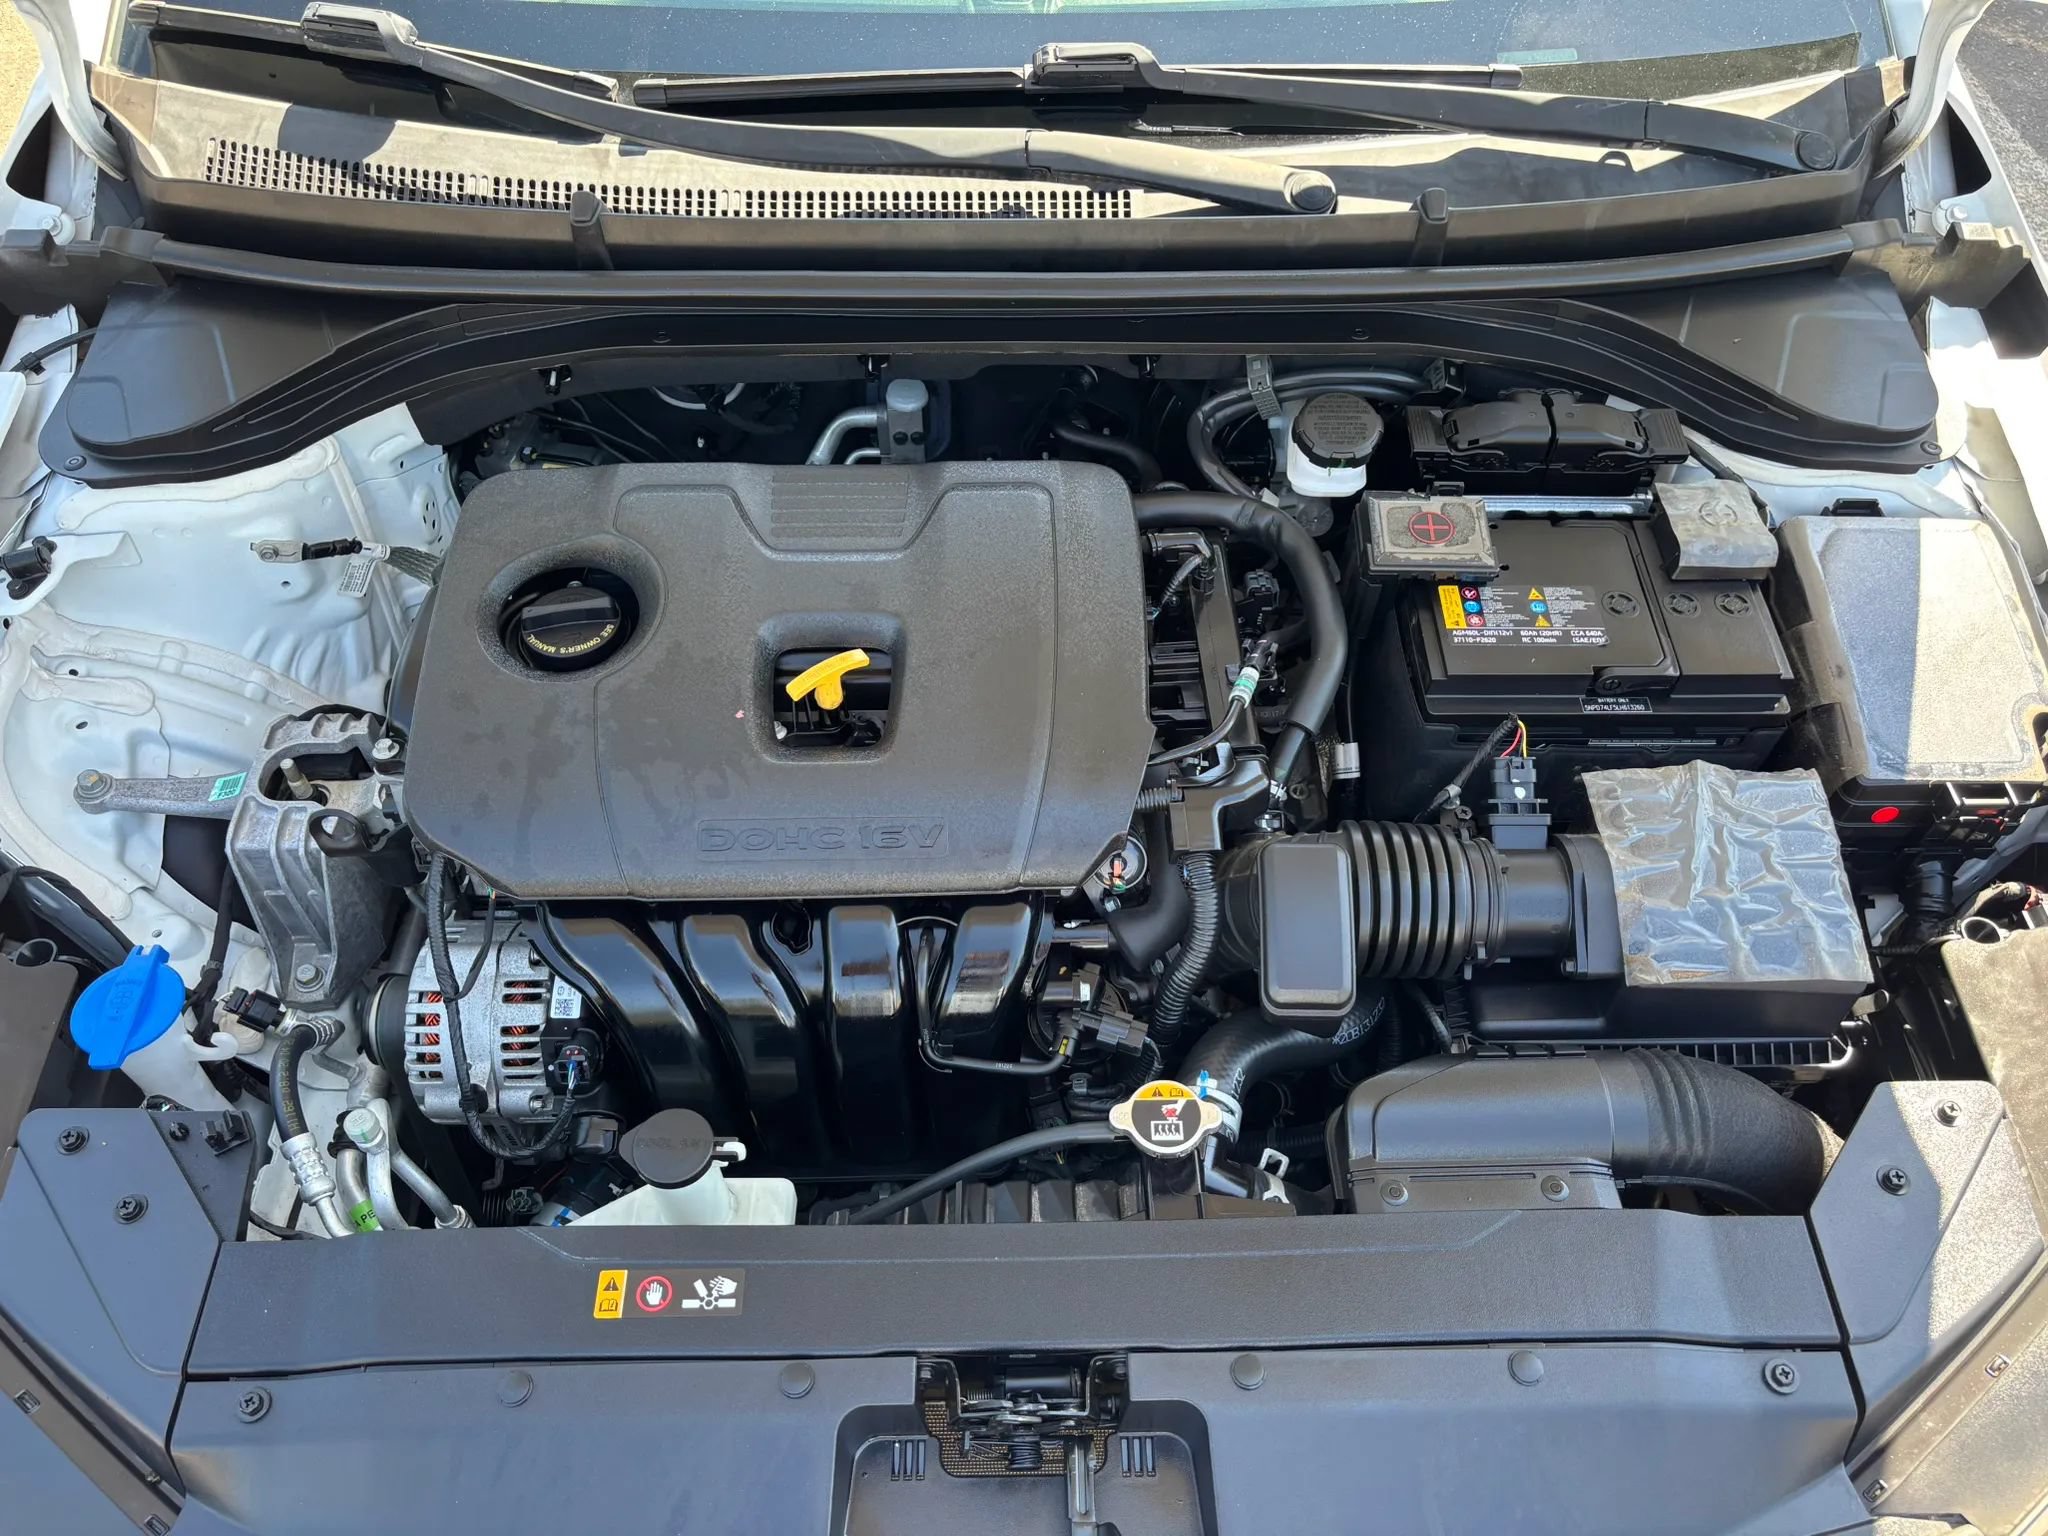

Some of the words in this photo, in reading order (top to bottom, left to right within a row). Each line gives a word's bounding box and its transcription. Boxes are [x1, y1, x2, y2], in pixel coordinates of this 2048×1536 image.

[600, 624, 615, 638] SEE
[527, 634, 557, 654] MANUAL
[560, 637, 601, 654] OWNER'S
[700, 827, 846, 852] DOHC
[858, 824, 944, 850] 16V
